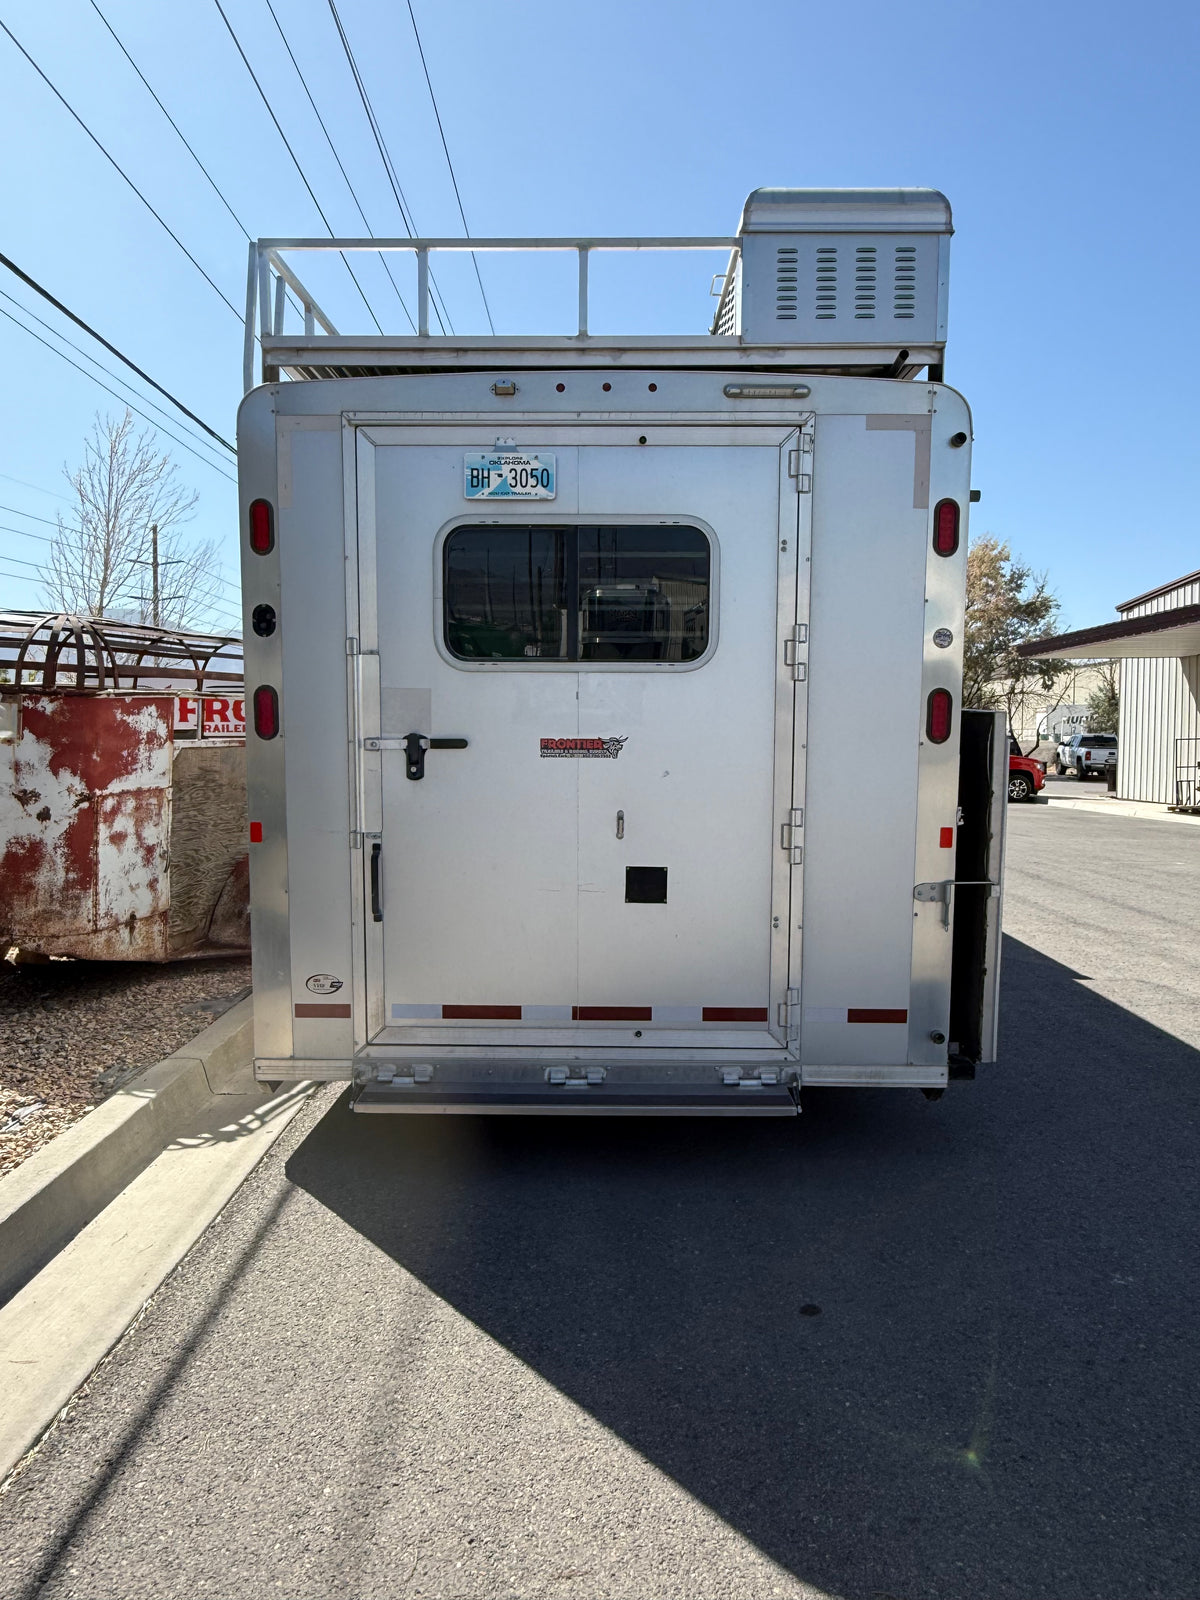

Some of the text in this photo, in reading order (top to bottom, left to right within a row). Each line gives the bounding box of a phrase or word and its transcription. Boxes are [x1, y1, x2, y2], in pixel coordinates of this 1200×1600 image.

[470, 468, 550, 488] BH 3050
[203, 724, 245, 733] RAILE
[540, 738, 604, 749] FRONTIER
